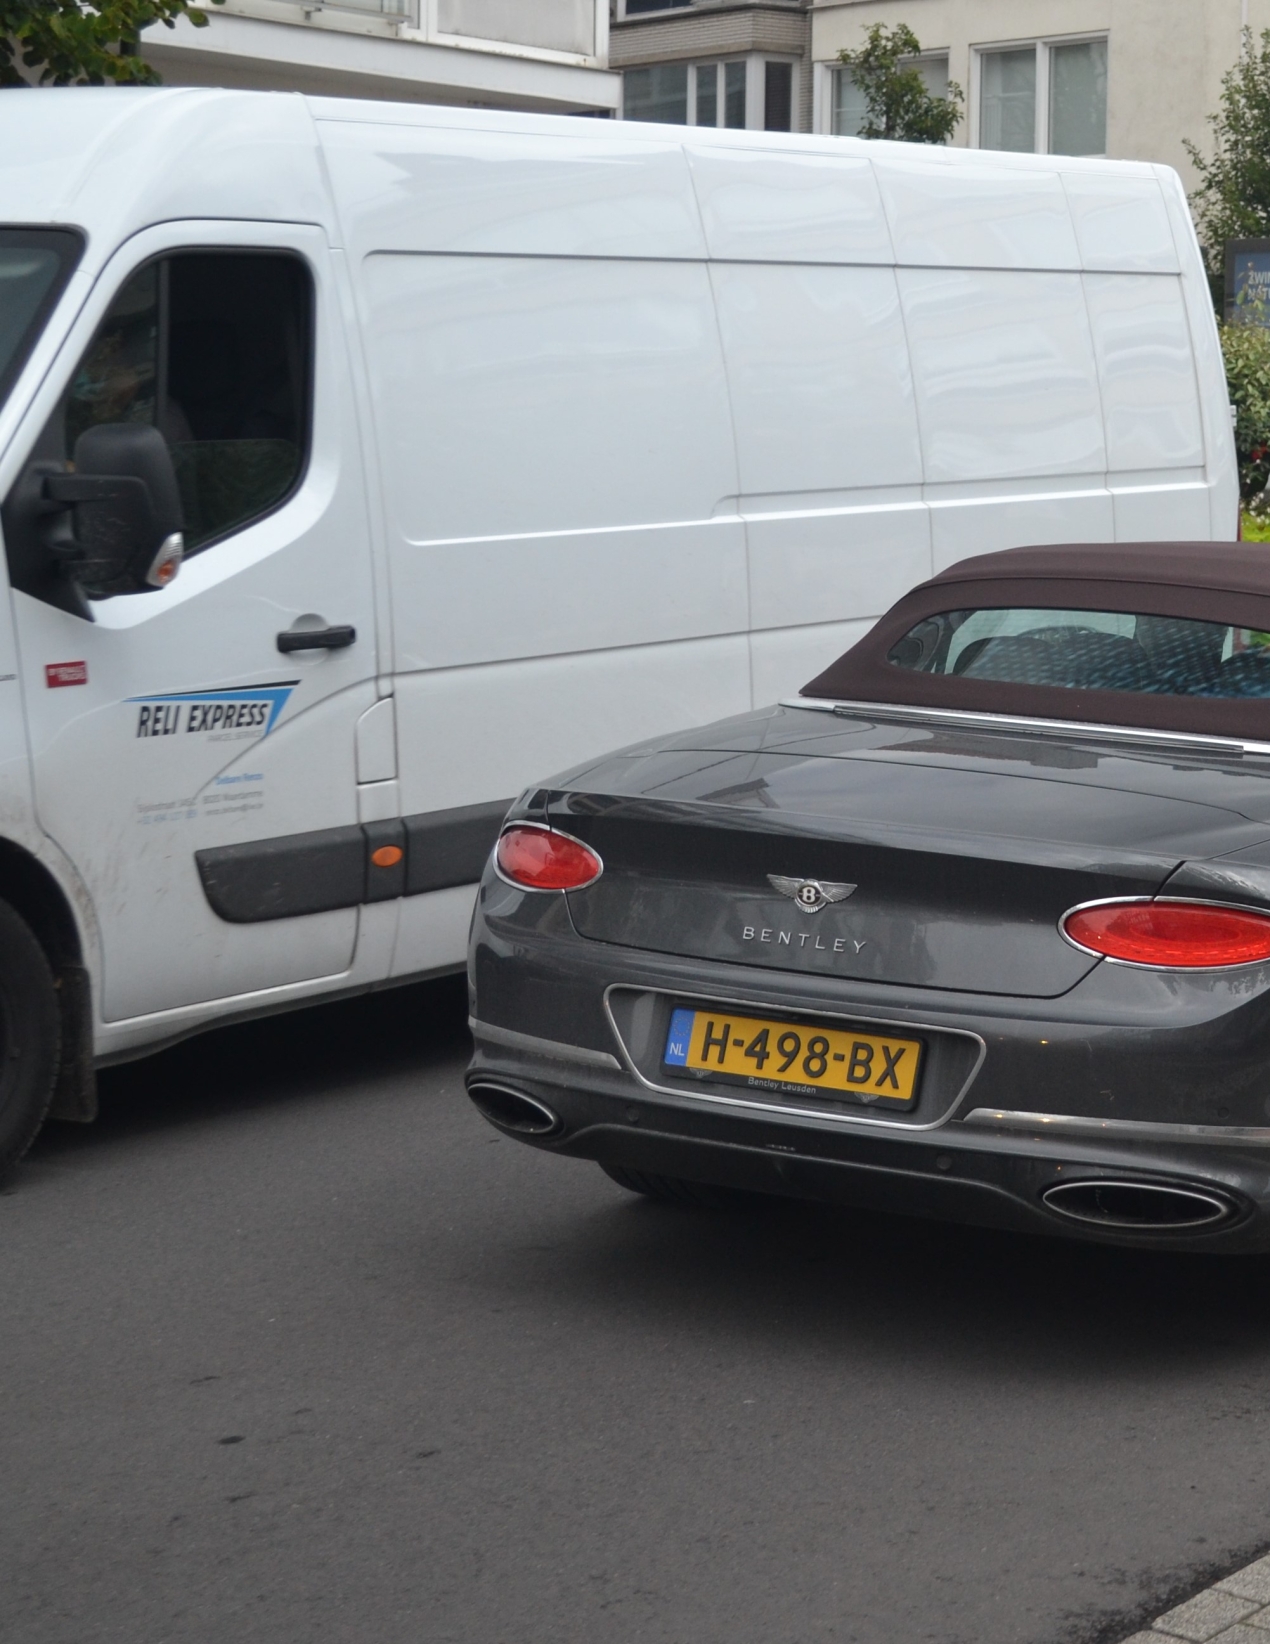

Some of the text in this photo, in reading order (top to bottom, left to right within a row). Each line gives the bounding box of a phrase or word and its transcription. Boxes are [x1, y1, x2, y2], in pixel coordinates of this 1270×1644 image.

[136, 703, 269, 738] RELI EXPRESS
[742, 926, 867, 954] BENTLEY
[669, 1042, 685, 1056] NL
[701, 1020, 906, 1090] H-498-BX
[748, 1076, 817, 1094] Bentley Leusden
